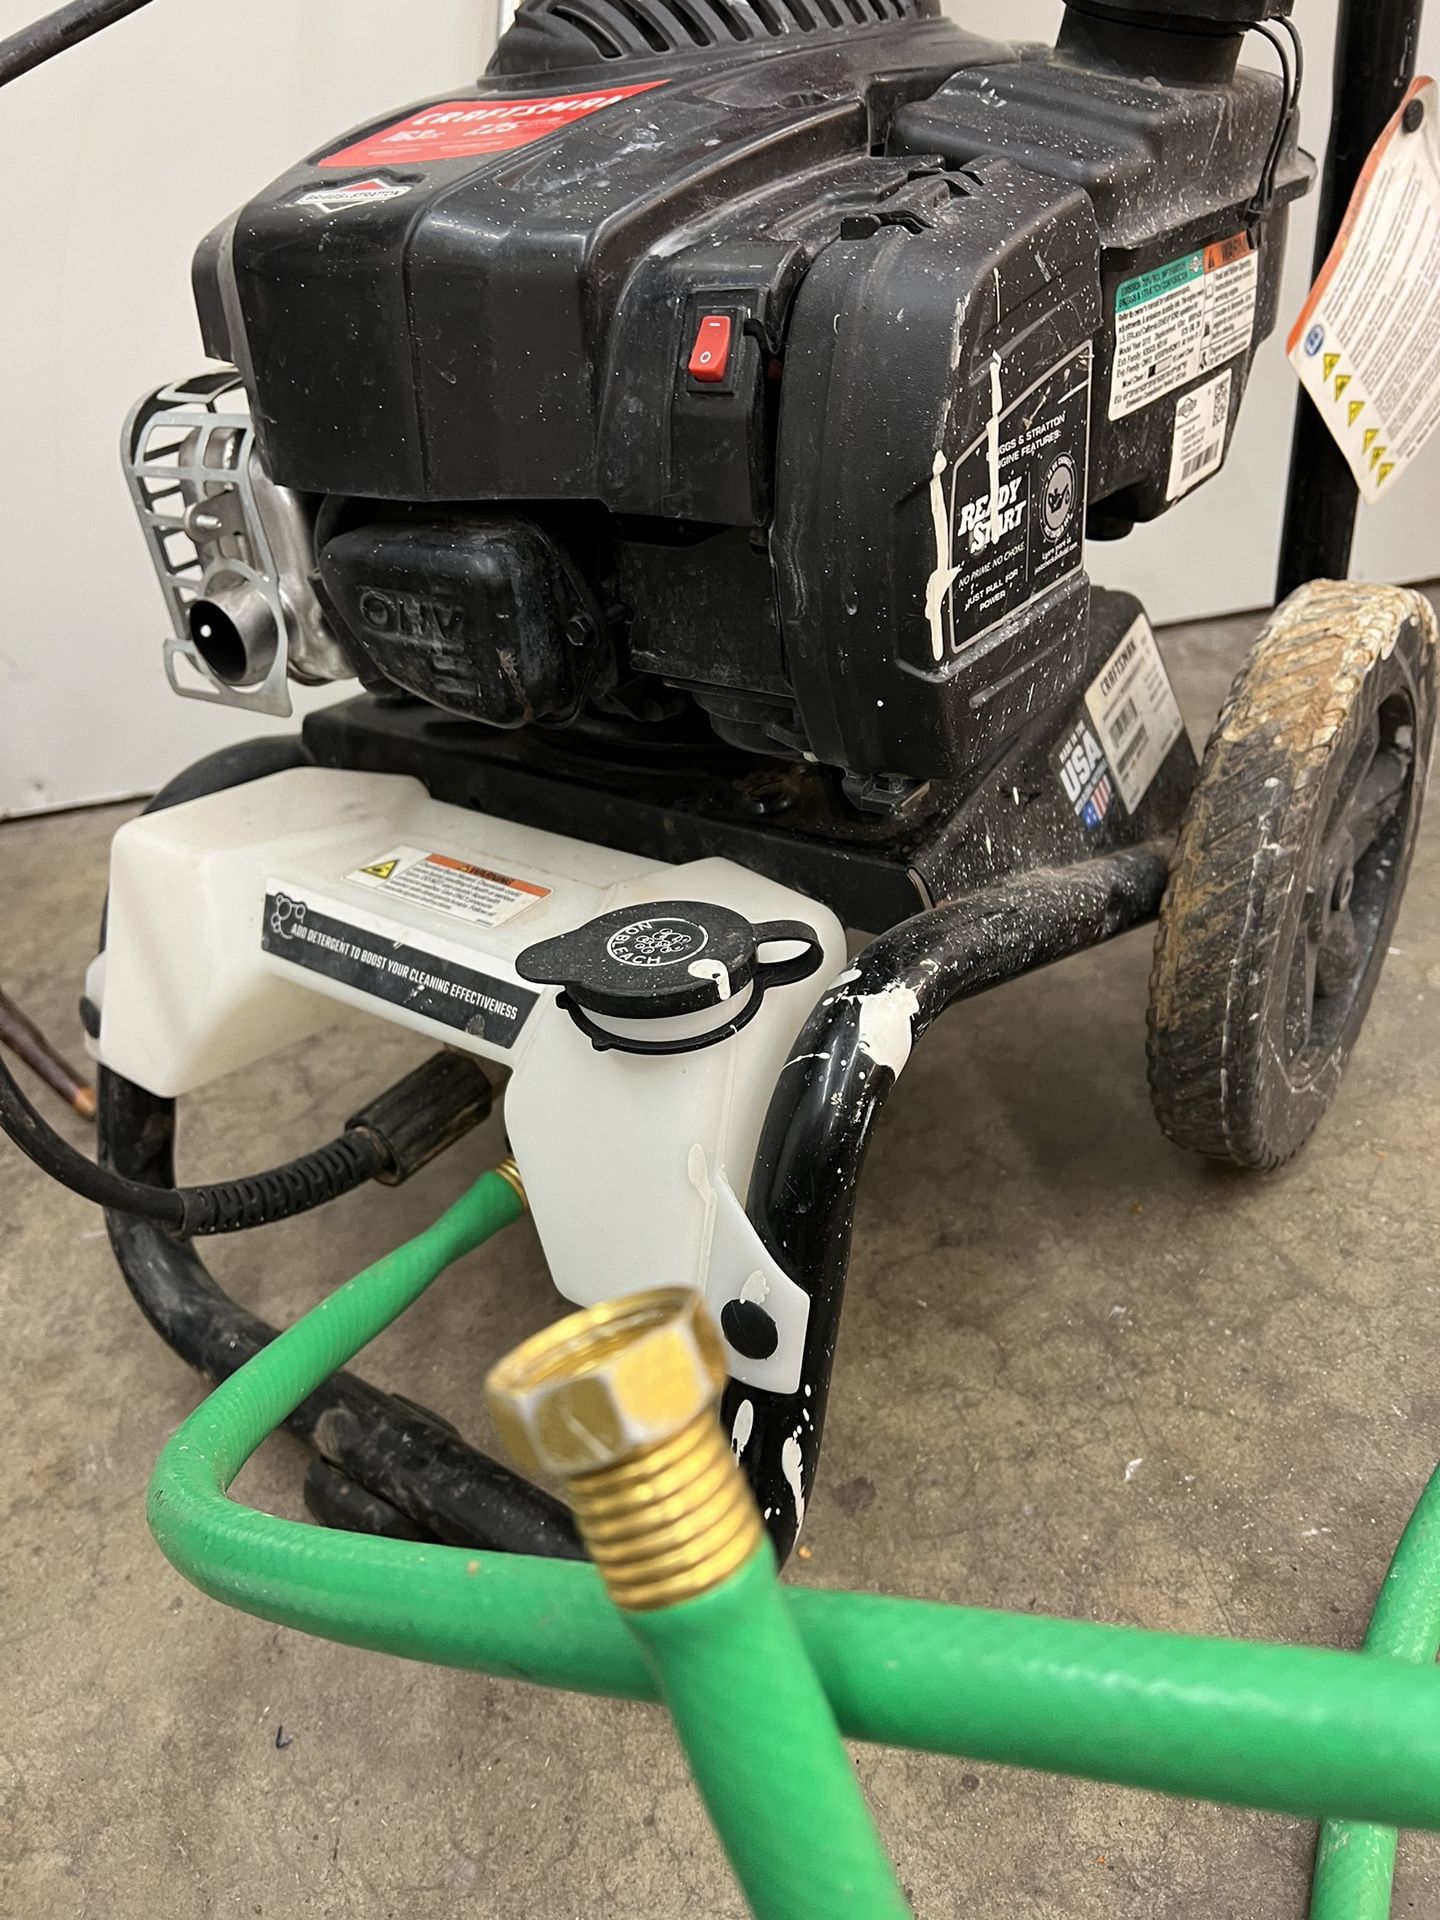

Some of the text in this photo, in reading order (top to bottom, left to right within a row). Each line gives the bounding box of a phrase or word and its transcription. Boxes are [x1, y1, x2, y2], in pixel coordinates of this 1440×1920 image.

[1018, 435, 1025, 445] &
[1026, 413, 1066, 441] STRATTON
[997, 451, 1020, 469] GINE
[959, 574, 970, 589] NO
[992, 555, 1003, 568] NO
[985, 579, 1004, 595] PULL
[1005, 568, 1019, 583] FOR
[979, 589, 1006, 612] POWER
[1100, 637, 1138, 698] CRAFTSMAN
[1059, 729, 1103, 803] USA
[611, 934, 661, 965] BLEACH
[291, 922, 518, 1021] ADD DETERGENT TO BOOST YOUR CLEANING EFFECTIVENESS
